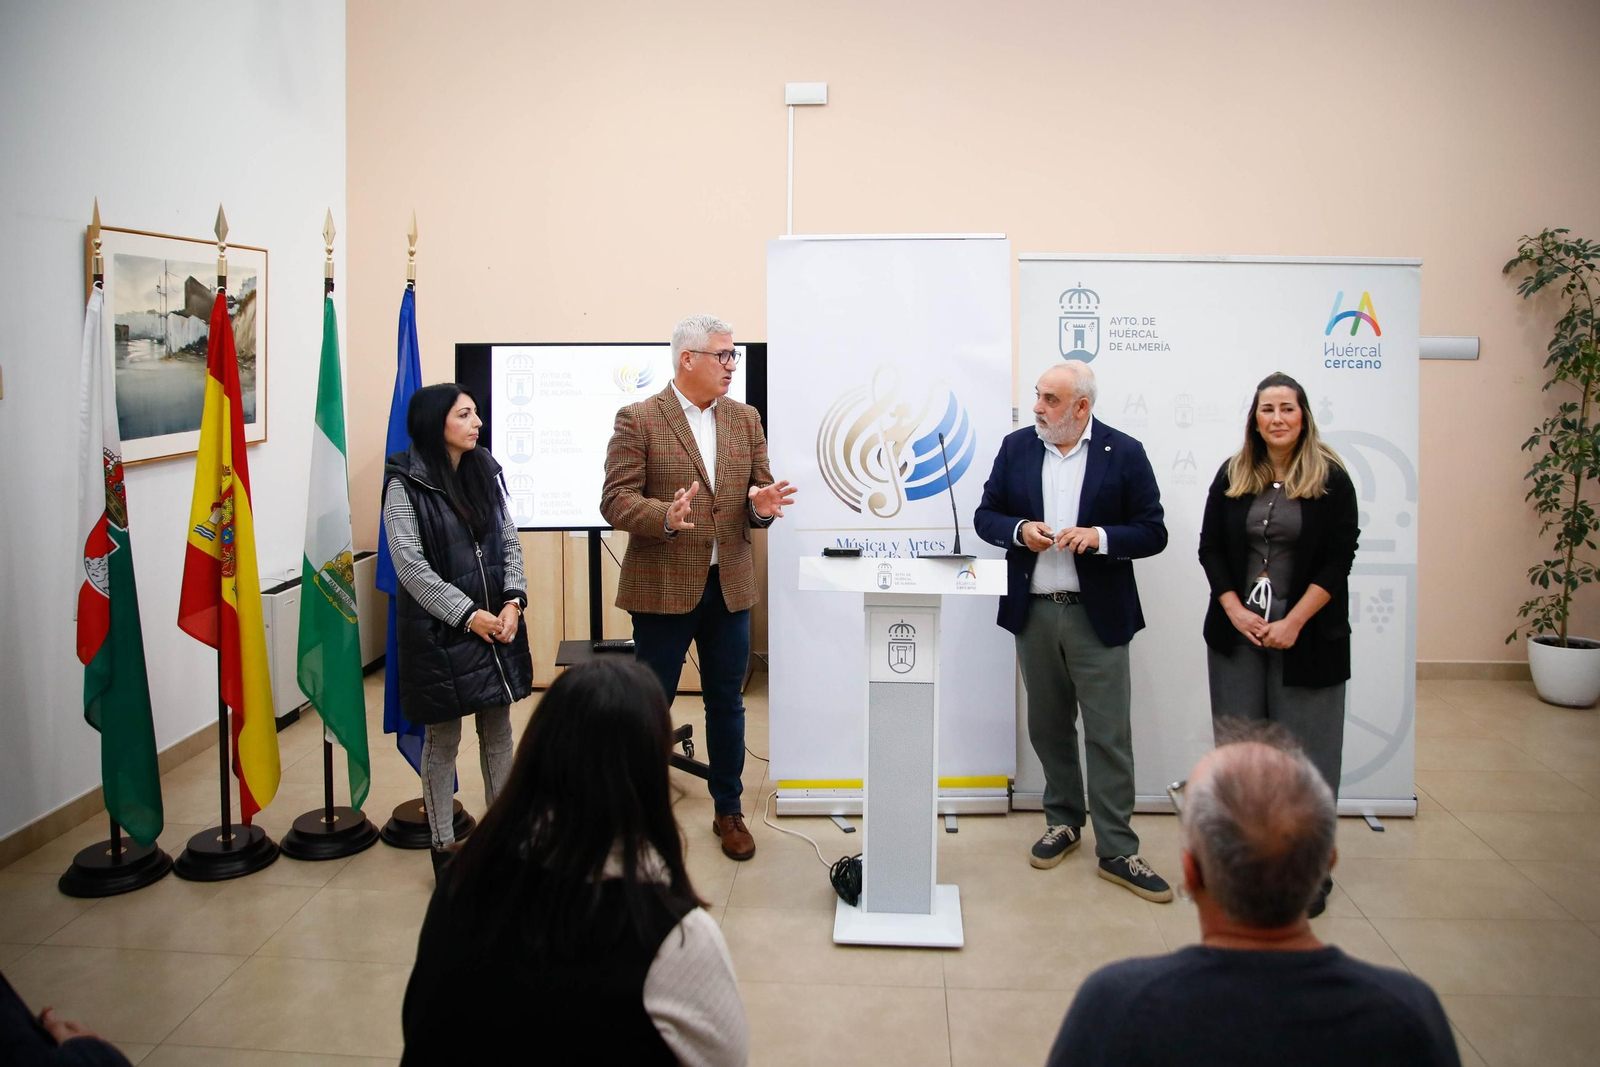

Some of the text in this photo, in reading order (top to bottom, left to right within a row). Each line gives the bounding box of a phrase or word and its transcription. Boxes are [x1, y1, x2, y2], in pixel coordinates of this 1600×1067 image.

[1109, 316, 1156, 326] AYTO. DE
[1109, 341, 1171, 352] DE ALMERÍA
[1324, 342, 1382, 357] Huércal
[1324, 359, 1382, 369] cercano
[836, 538, 946, 554] Música y Artes
